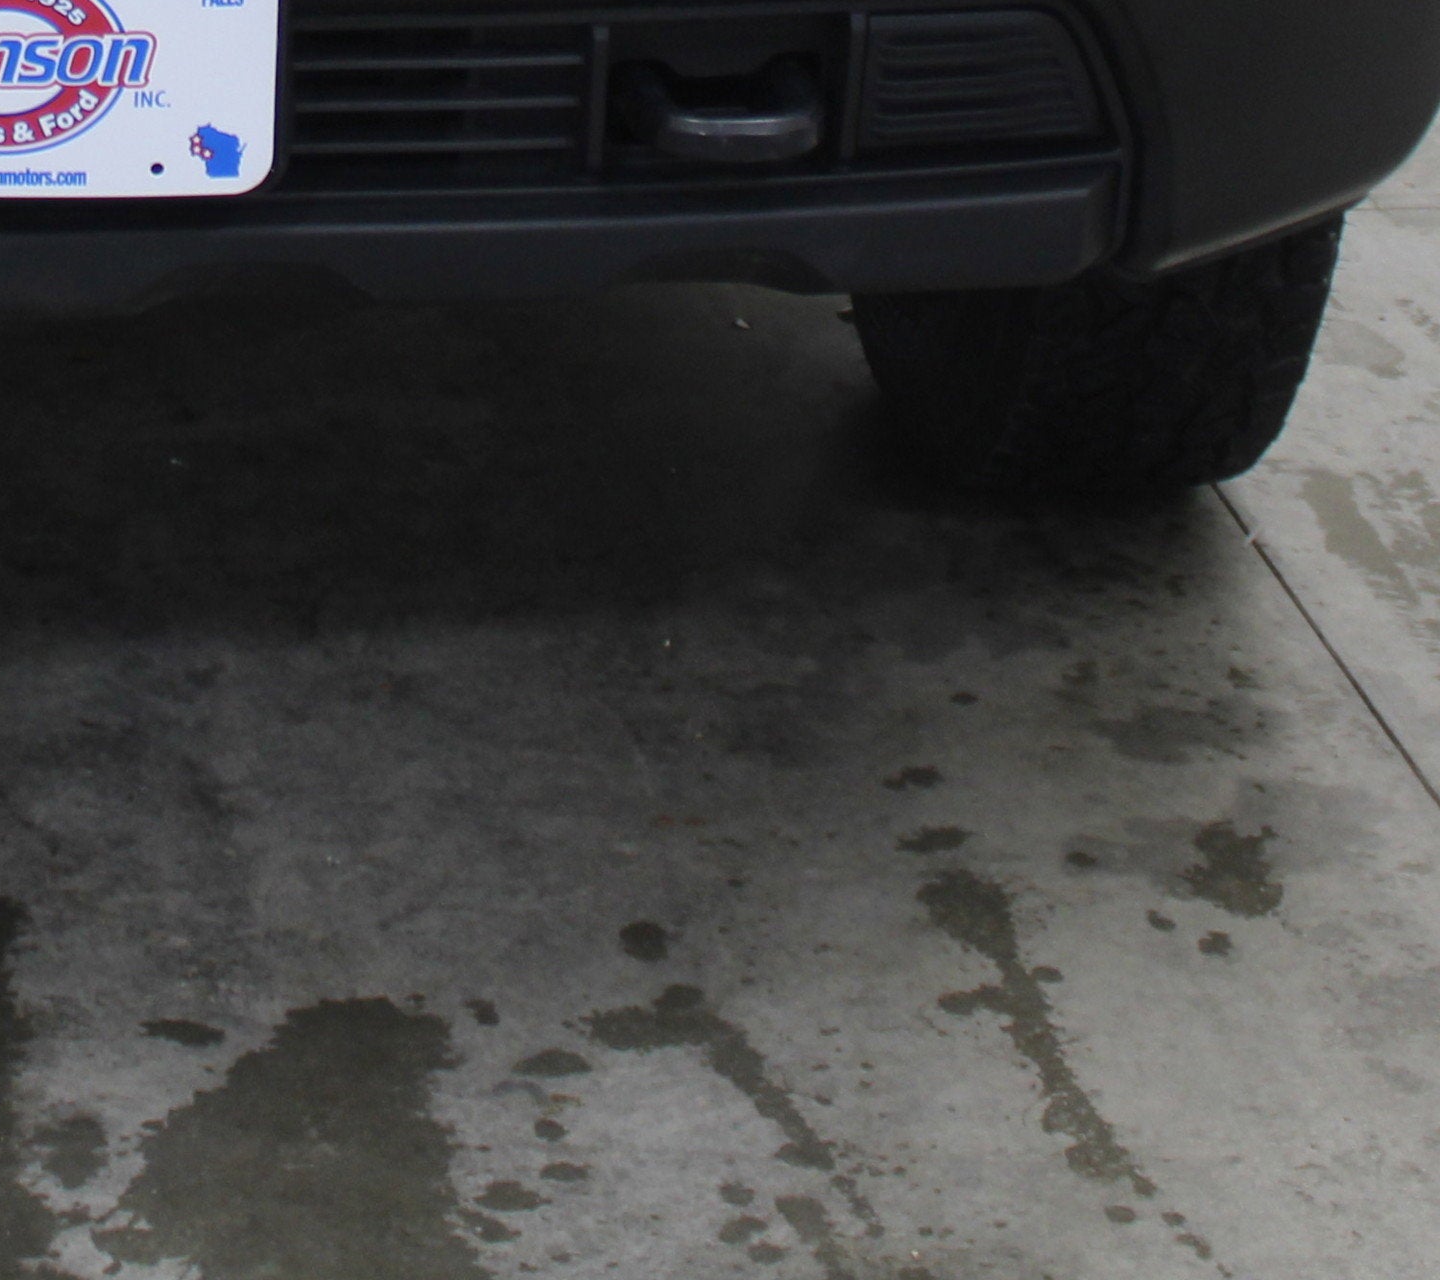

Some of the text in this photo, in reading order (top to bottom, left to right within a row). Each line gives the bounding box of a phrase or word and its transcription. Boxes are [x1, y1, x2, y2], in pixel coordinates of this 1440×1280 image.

[13, 122, 35, 143] &
[38, 90, 99, 138] Ford
[133, 91, 172, 108] INC.
